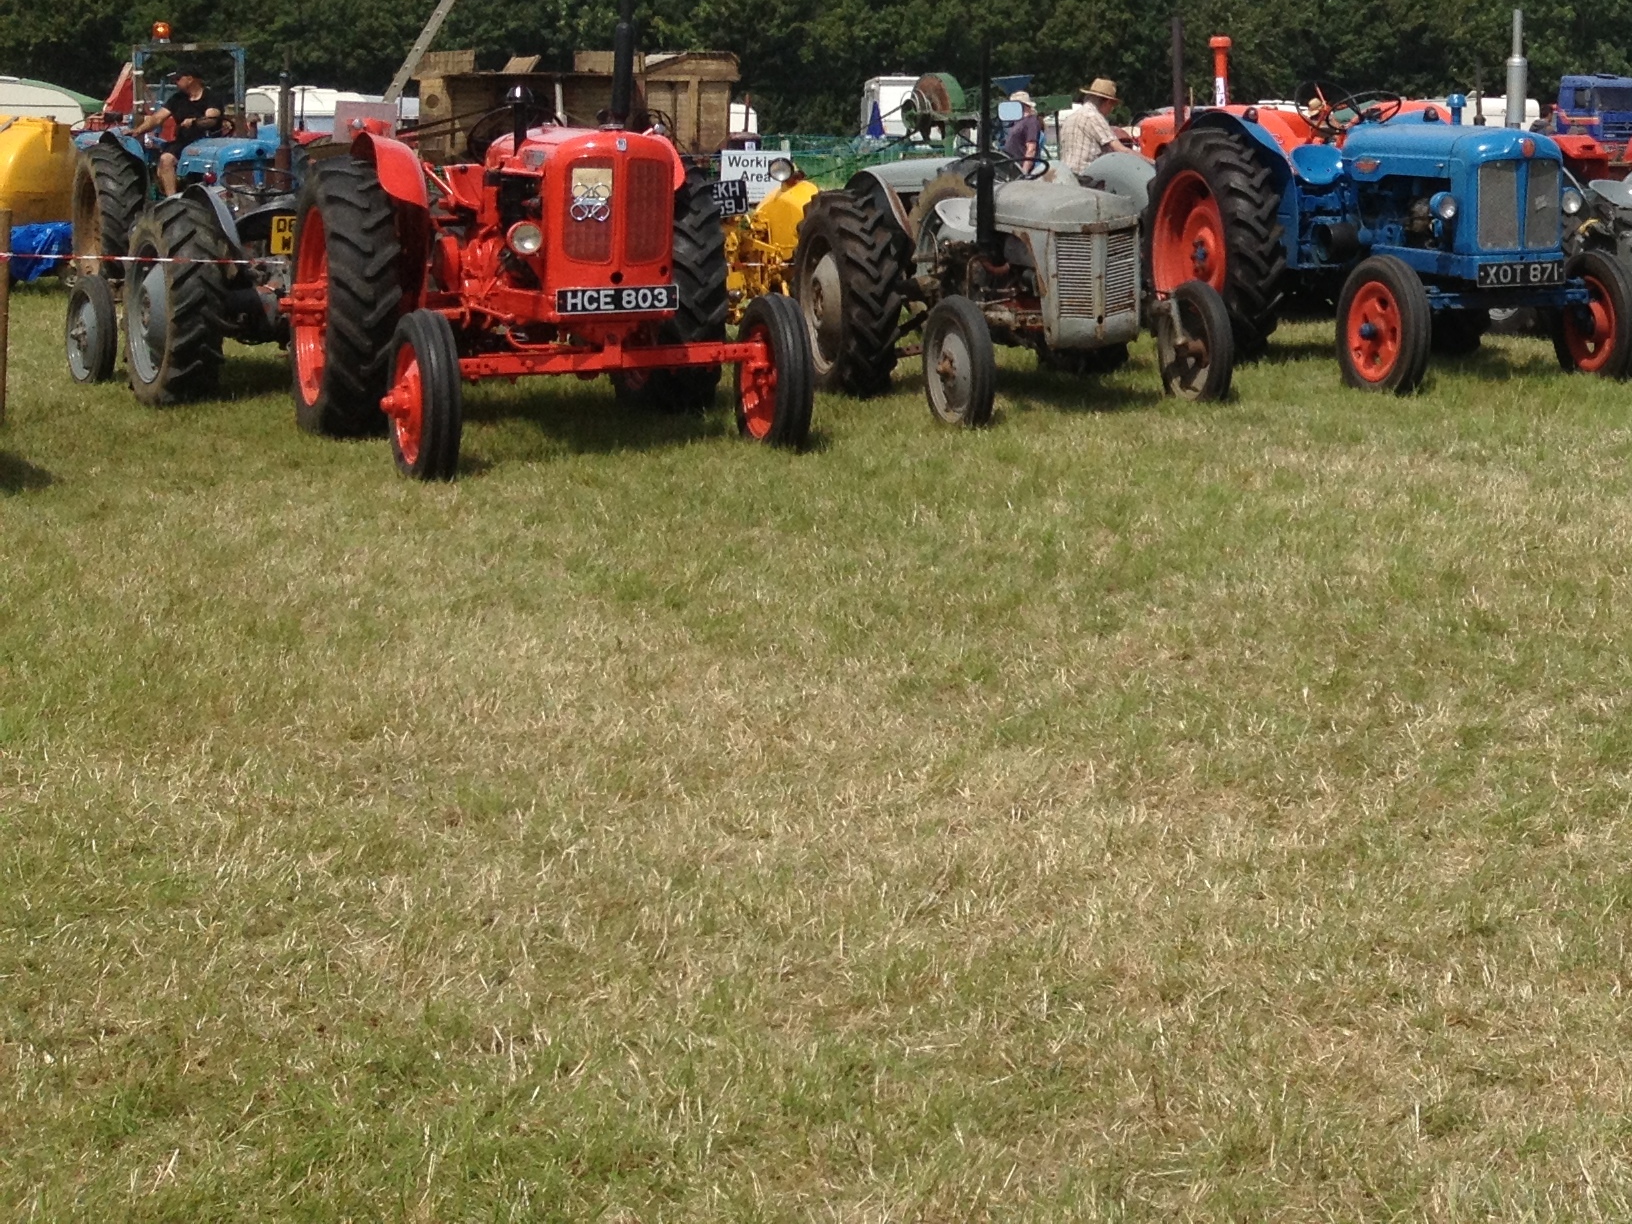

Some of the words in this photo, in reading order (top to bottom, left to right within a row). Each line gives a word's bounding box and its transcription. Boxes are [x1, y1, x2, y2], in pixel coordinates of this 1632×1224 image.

[728, 156, 774, 168] Worki
[741, 171, 771, 182] Area
[1486, 265, 1524, 284] XOT
[1530, 263, 1558, 282] 871
[567, 290, 615, 311] HCE
[622, 288, 668, 309] 803
